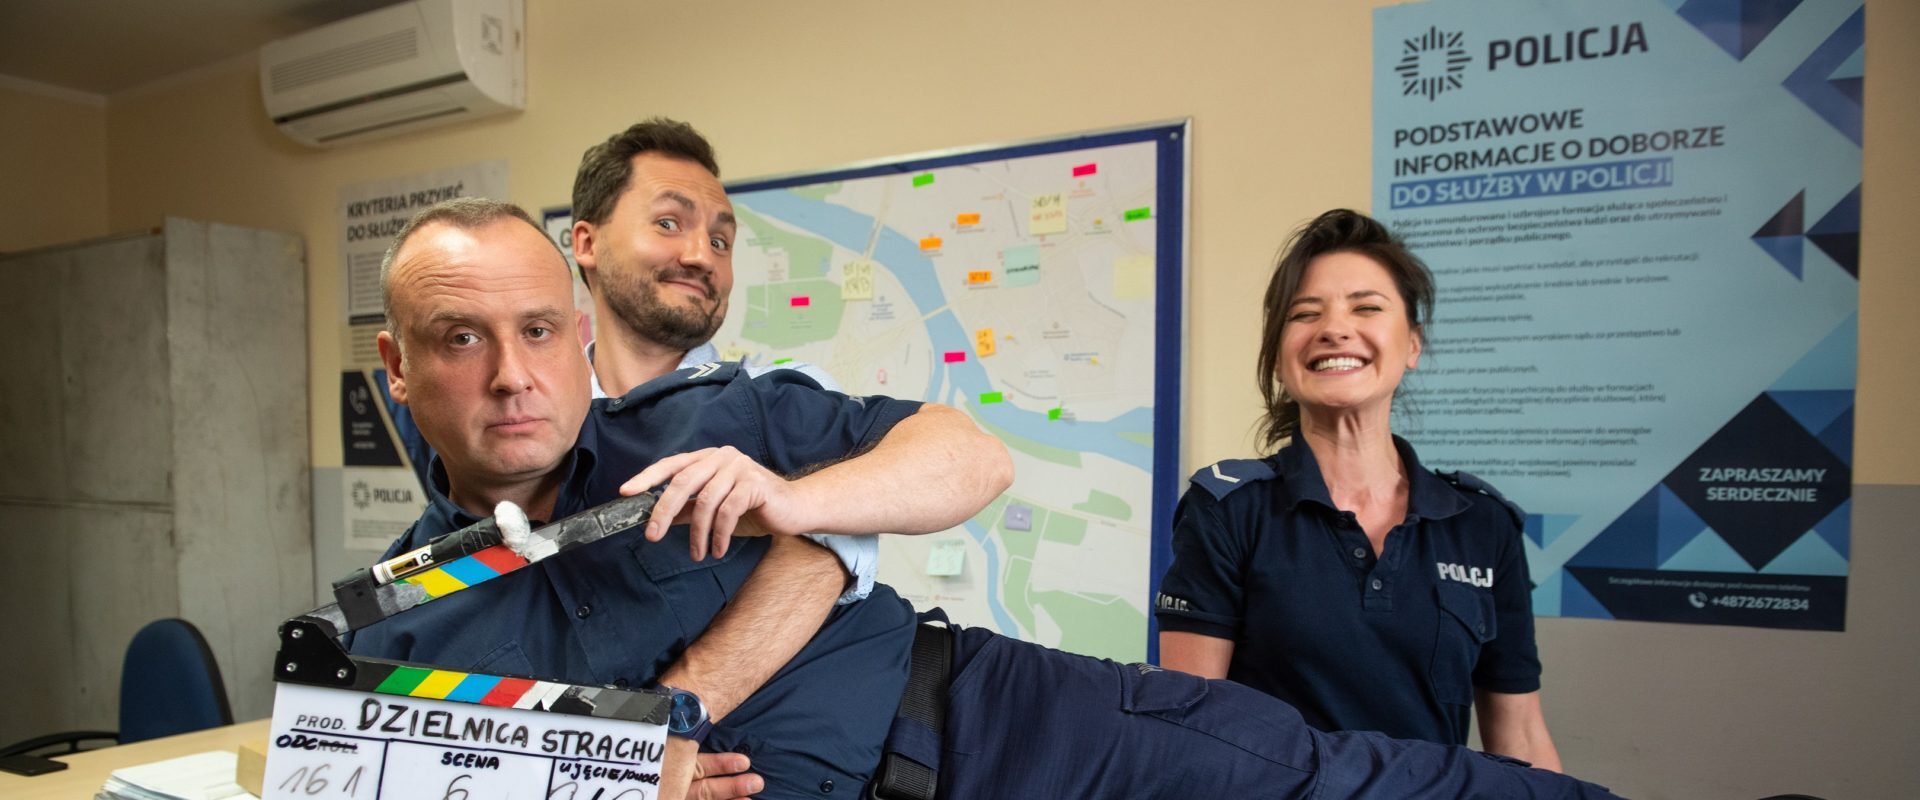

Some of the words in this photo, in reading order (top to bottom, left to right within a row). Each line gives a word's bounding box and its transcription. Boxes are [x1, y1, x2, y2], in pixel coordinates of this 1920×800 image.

[1488, 22, 1649, 71] POLICJA
[1394, 108, 1585, 148] PODSTAWOWE
[1394, 137, 1555, 177] INFORMACJE
[1561, 138, 1582, 160] O
[1588, 125, 1726, 158] DOBORZE
[1394, 183, 1432, 206] DO
[1435, 172, 1533, 202] SŁUŻBY
[1537, 170, 1570, 193] W
[1576, 161, 1674, 190] POLICJI
[347, 193, 408, 219] KRYTERIA
[1513, 207, 1561, 220] uzbrojona
[1562, 203, 1605, 215] formacja
[1607, 200, 1644, 212] służąca
[1646, 195, 1723, 210] społeczeństwu
[347, 224, 366, 242] DO
[367, 216, 408, 239] SŁUŻB
[1455, 226, 1466, 236] do
[1468, 224, 1505, 236] ochrony
[1507, 217, 1583, 232] bezpieczeństwa
[1585, 215, 1609, 226] ludzi
[1610, 214, 1631, 224] oraz
[1634, 212, 1646, 223] do
[1648, 207, 1722, 222] utrzymywania
[1469, 234, 1513, 247] porządku
[1514, 230, 1573, 244] publicznego.
[1699, 467, 1827, 483] ZAPRASZAMY
[373, 488, 413, 503] POLICJA
[1706, 487, 1818, 502] SERDECZNIE
[1437, 562, 1494, 588] POLCJ
[1712, 595, 1810, 611] +4872672834
[295, 714, 347, 731] PROD.
[357, 698, 530, 748] DZIELNICA
[541, 729, 665, 763] STRACHU
[441, 752, 501, 770] SCENA
